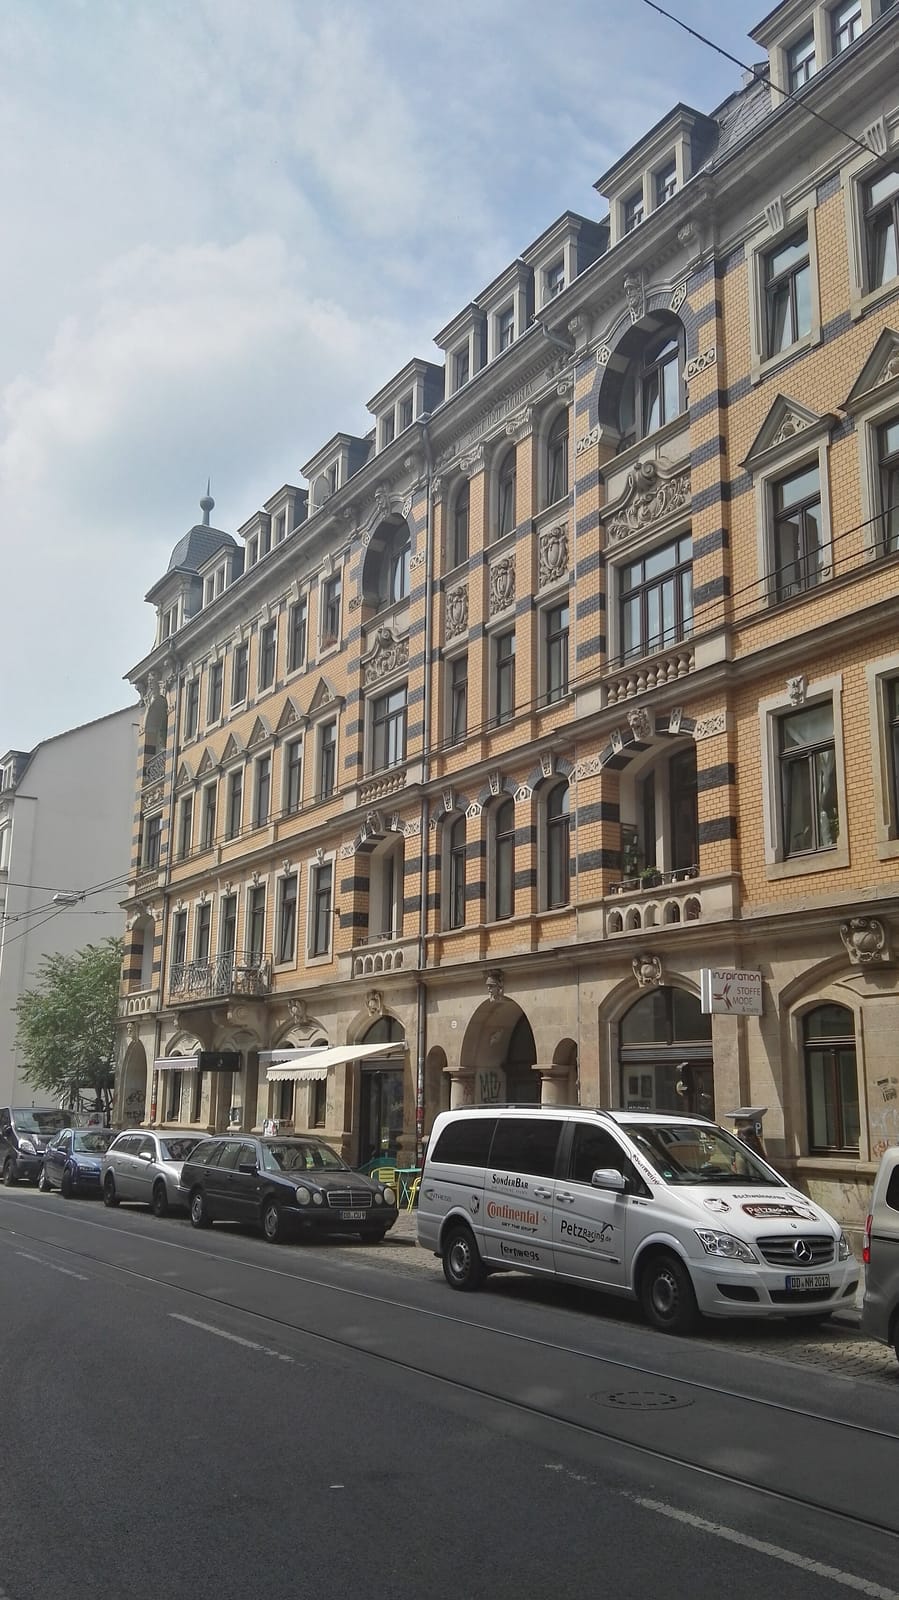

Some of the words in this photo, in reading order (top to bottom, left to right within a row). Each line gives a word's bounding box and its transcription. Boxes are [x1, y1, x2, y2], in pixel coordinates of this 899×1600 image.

[712, 971, 761, 982] inspiration
[736, 986, 761, 996] STOFFE
[732, 997, 753, 1006] MODE
[487, 1200, 539, 1226] Continental
[791, 1277, 801, 1288] DD
[804, 1276, 814, 1287] NH
[814, 1275, 829, 1287] 2012
